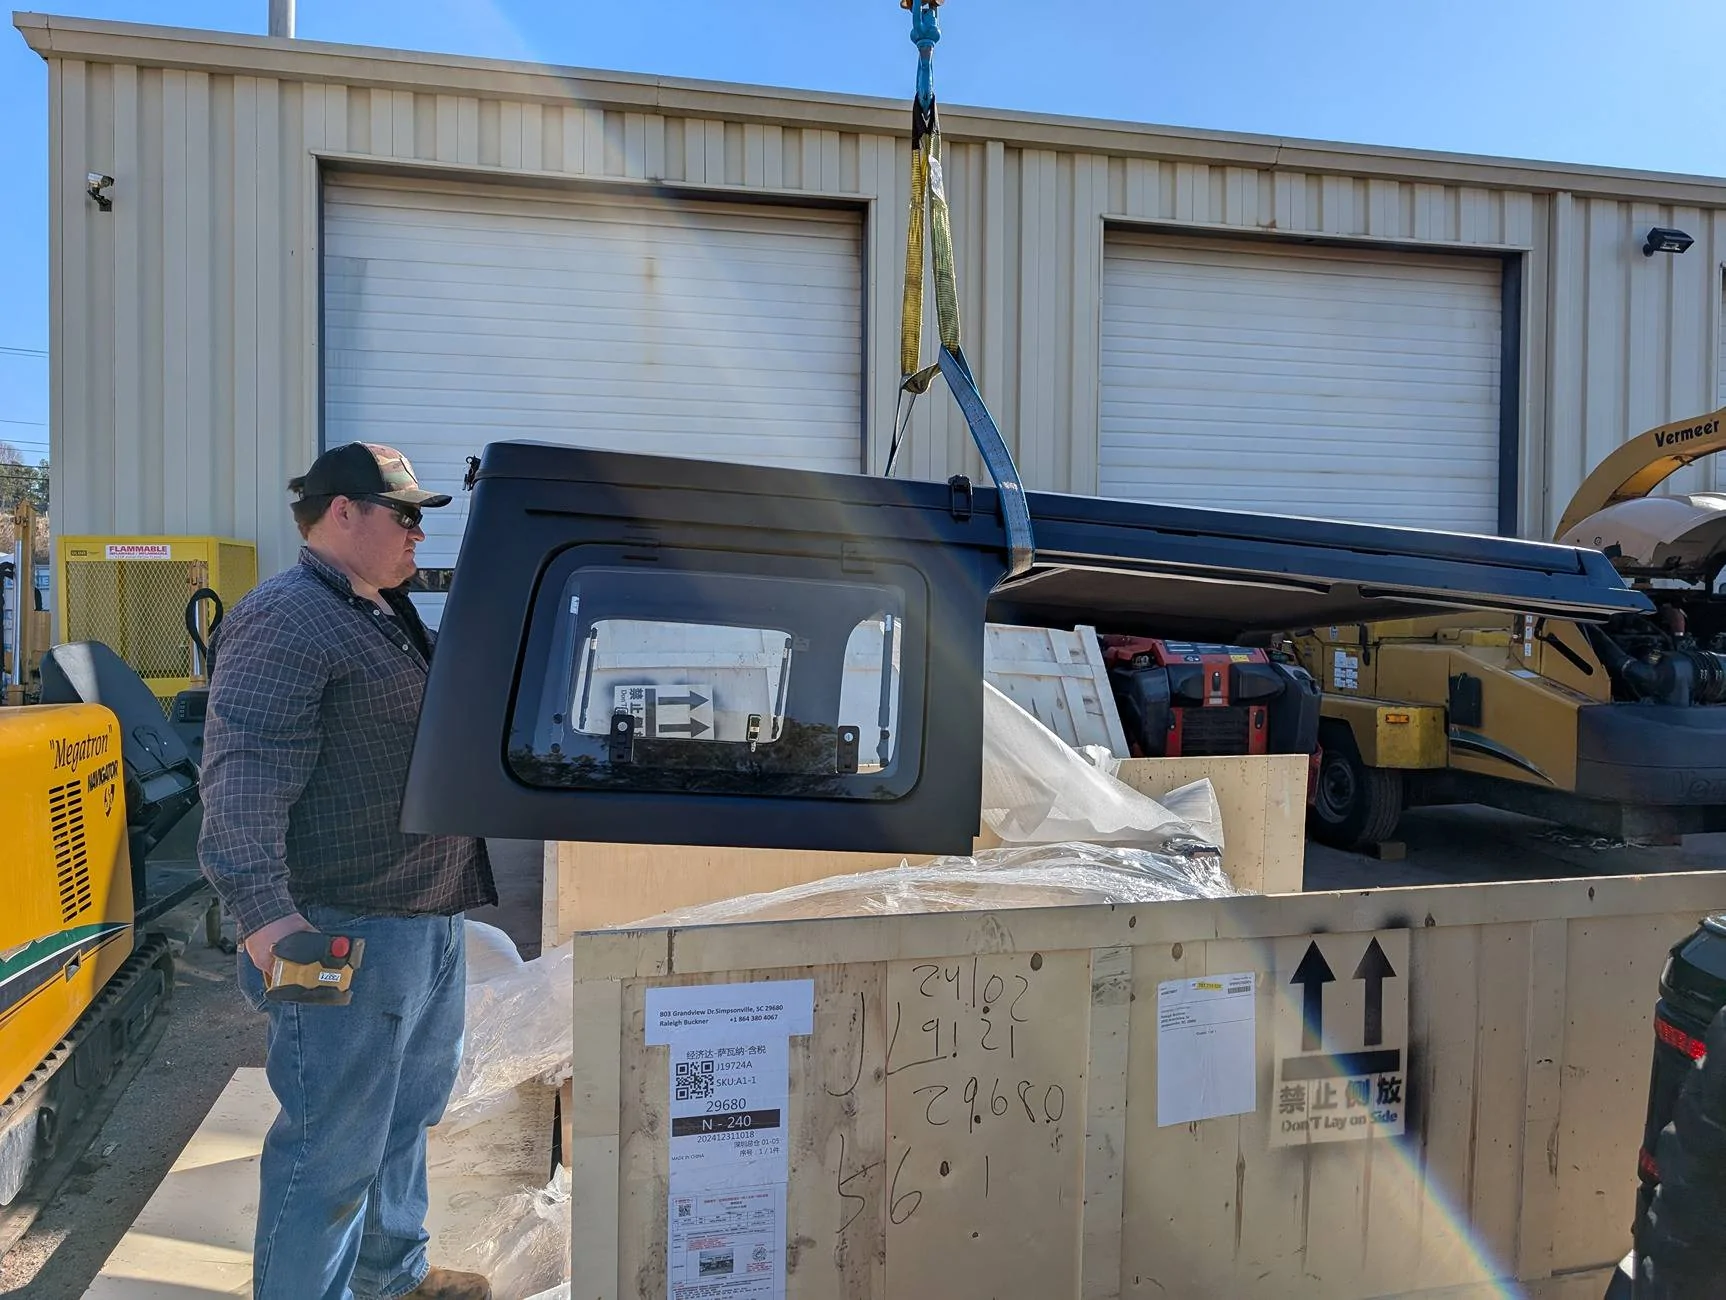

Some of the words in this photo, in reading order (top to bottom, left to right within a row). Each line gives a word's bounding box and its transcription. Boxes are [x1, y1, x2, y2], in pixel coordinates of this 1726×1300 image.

[1654, 420, 1720, 448] Vermeer
[109, 545, 168, 553] FLAMMABLE
[49, 723, 113, 773] "Megatron"
[87, 759, 119, 793] NAVIGATOR
[673, 1009, 706, 1017] Grandview
[660, 1020, 682, 1028] Raleigh
[684, 1018, 709, 1026] Buckner
[716, 1060, 753, 1071] J19724A
[716, 1076, 757, 1087] SKU:A1-1
[1279, 1076, 1402, 1114] 禁止侧放
[706, 1098, 747, 1113] 29680
[912, 1076, 1064, 1133] 29680
[702, 1118, 713, 1131] N
[727, 1115, 752, 1129] 240
[1324, 1115, 1348, 1132] Lay
[1350, 1113, 1367, 1126] on
[1370, 1110, 1398, 1124] Side
[697, 1130, 755, 1143] 202412311018
